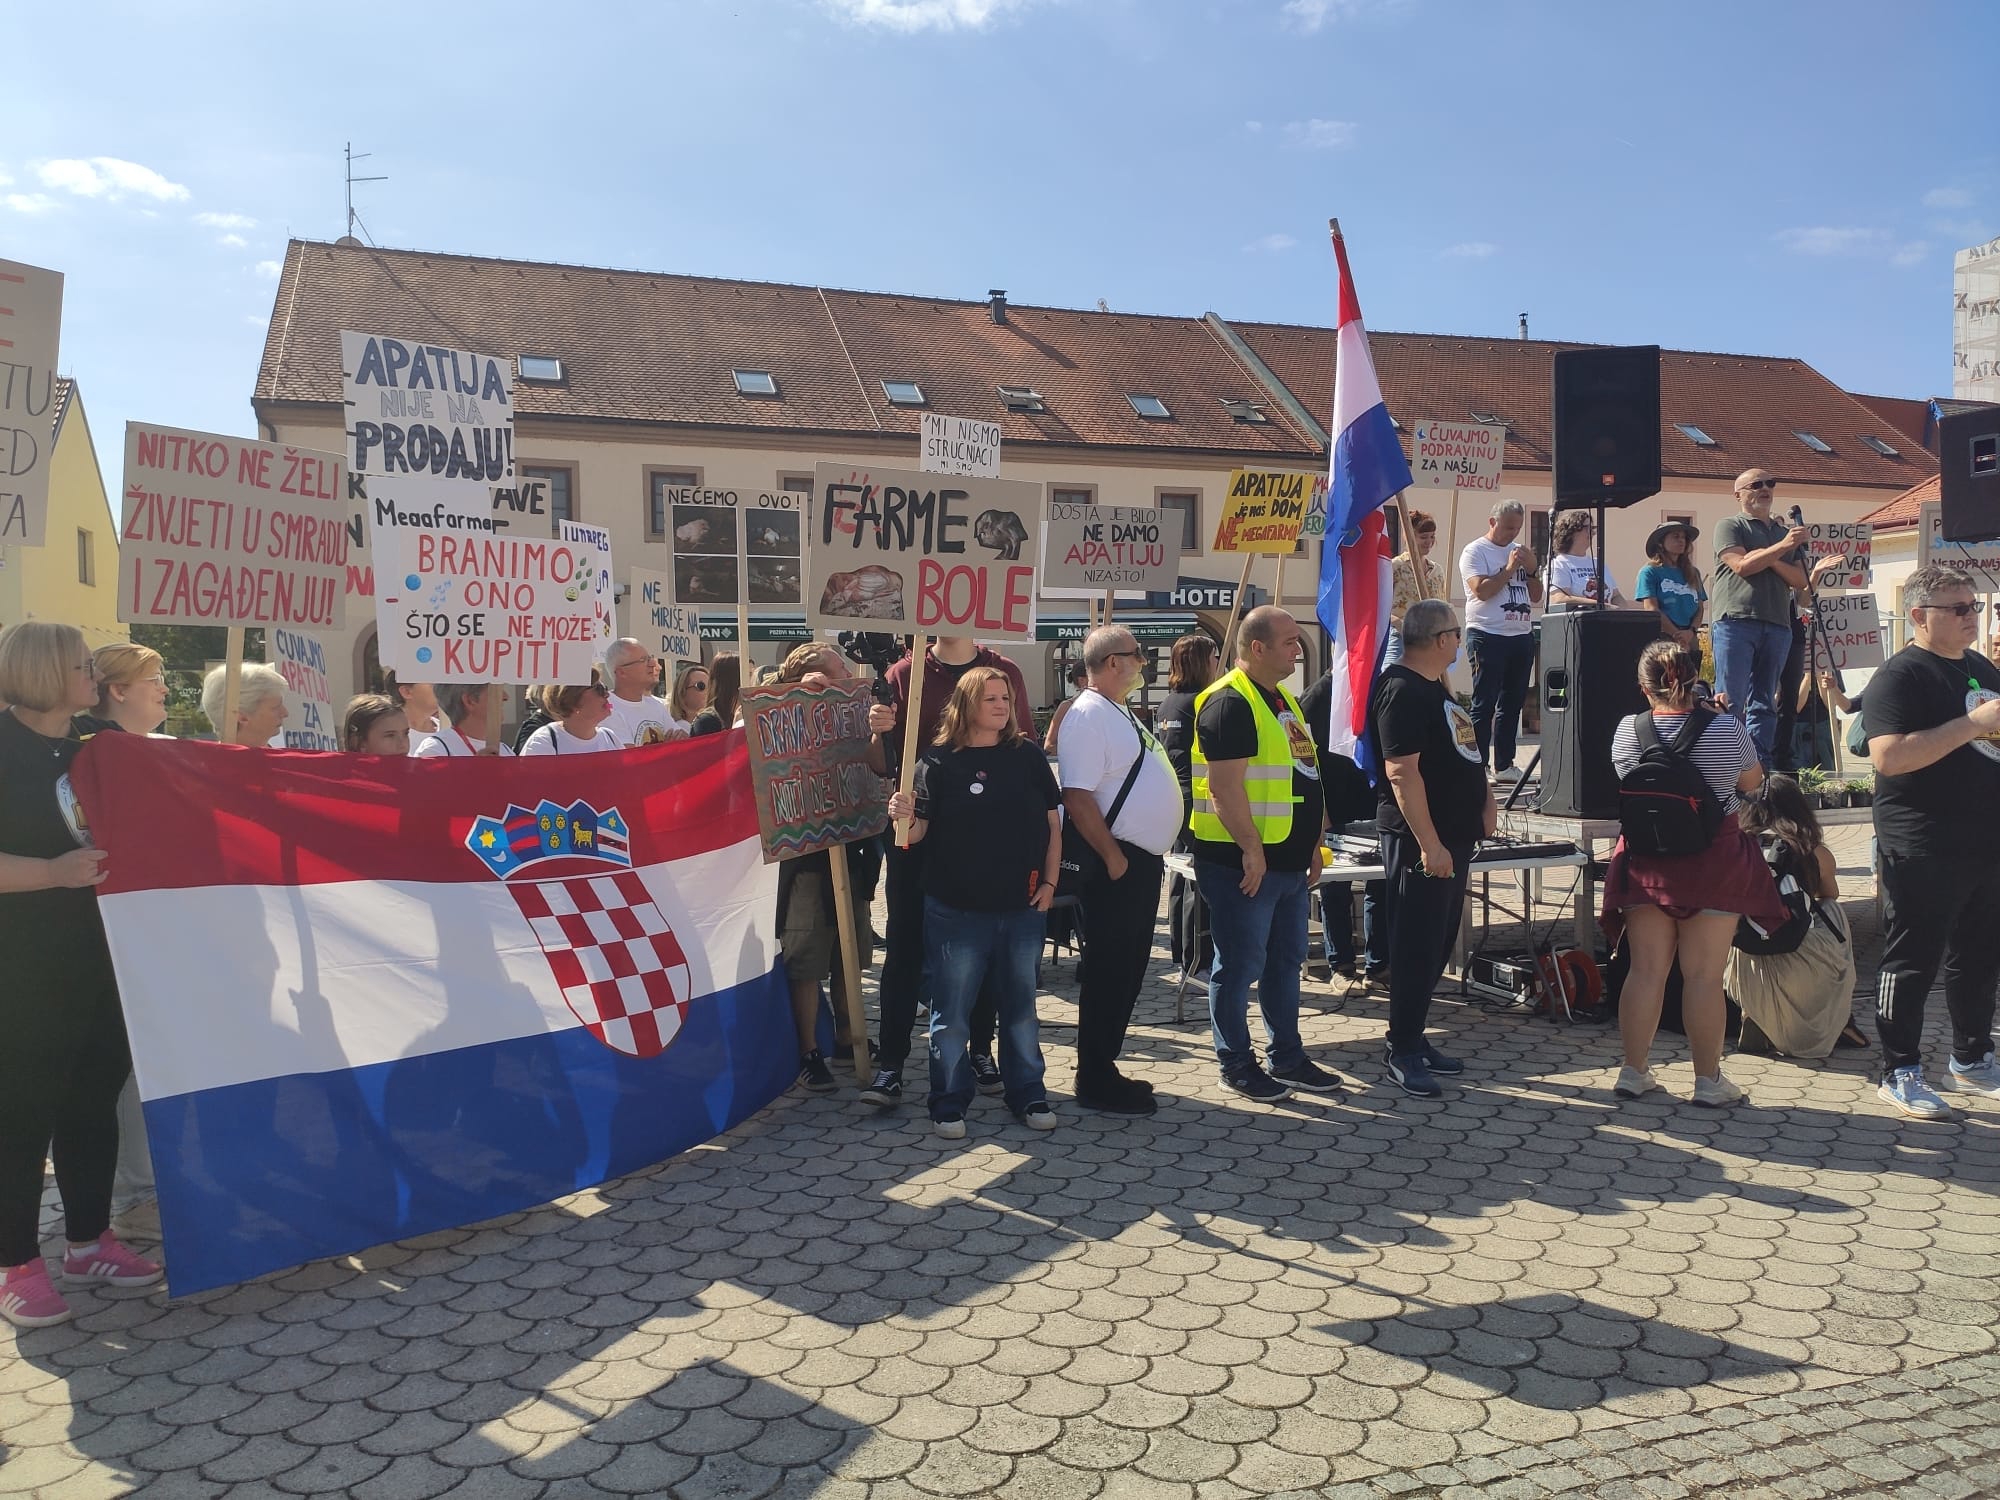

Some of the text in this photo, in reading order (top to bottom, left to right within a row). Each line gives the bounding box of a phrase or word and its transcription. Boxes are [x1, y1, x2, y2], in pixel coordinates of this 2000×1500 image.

[355, 337, 507, 404] APATIJA
[380, 390, 484, 425] NIJE NA
[958, 420, 1000, 447] NISMO
[1429, 422, 1490, 445] ČUVAJMO
[355, 421, 512, 482] PRODAJU!
[1421, 443, 1497, 461] PODRAVINU
[137, 431, 230, 479] NITKO
[238, 447, 274, 489] NE
[279, 447, 339, 500] ŽELI
[1421, 457, 1478, 474] ZA NAŠU
[1231, 473, 1304, 499] APATIJA
[1455, 473, 1501, 490] DJECU!
[668, 487, 738, 506] NEĆEMO
[1270, 498, 1304, 520] DOM
[124, 483, 234, 550] ŽIVJETI
[242, 506, 262, 553] U
[267, 511, 349, 566] SMRADU
[822, 482, 970, 555] FARME
[1052, 503, 1100, 521] DOSTA
[1110, 507, 1124, 521] JE
[1083, 523, 1159, 543] NE DAMO
[1214, 516, 1246, 551] NE
[418, 534, 574, 583] BRANIMO
[1064, 541, 1164, 567] APATIJU
[1811, 540, 1872, 555] PRAVO NA
[1084, 566, 1145, 584] NIZAŠTO!
[133, 557, 141, 614] I
[150, 558, 336, 625] ZAGAĐENJU!
[464, 580, 535, 611] ONO
[642, 581, 661, 605] NE
[916, 558, 1033, 633] BOLE
[406, 609, 450, 639] ŠTO
[457, 613, 486, 636] SE
[508, 615, 533, 638] NE
[651, 605, 684, 633] MIRIŠE
[662, 635, 691, 657] DOBRO
[700, 628, 721, 638] AN
[1058, 628, 1082, 638] PAN
[444, 638, 560, 678] KUPITI
[303, 702, 323, 731] ZA
